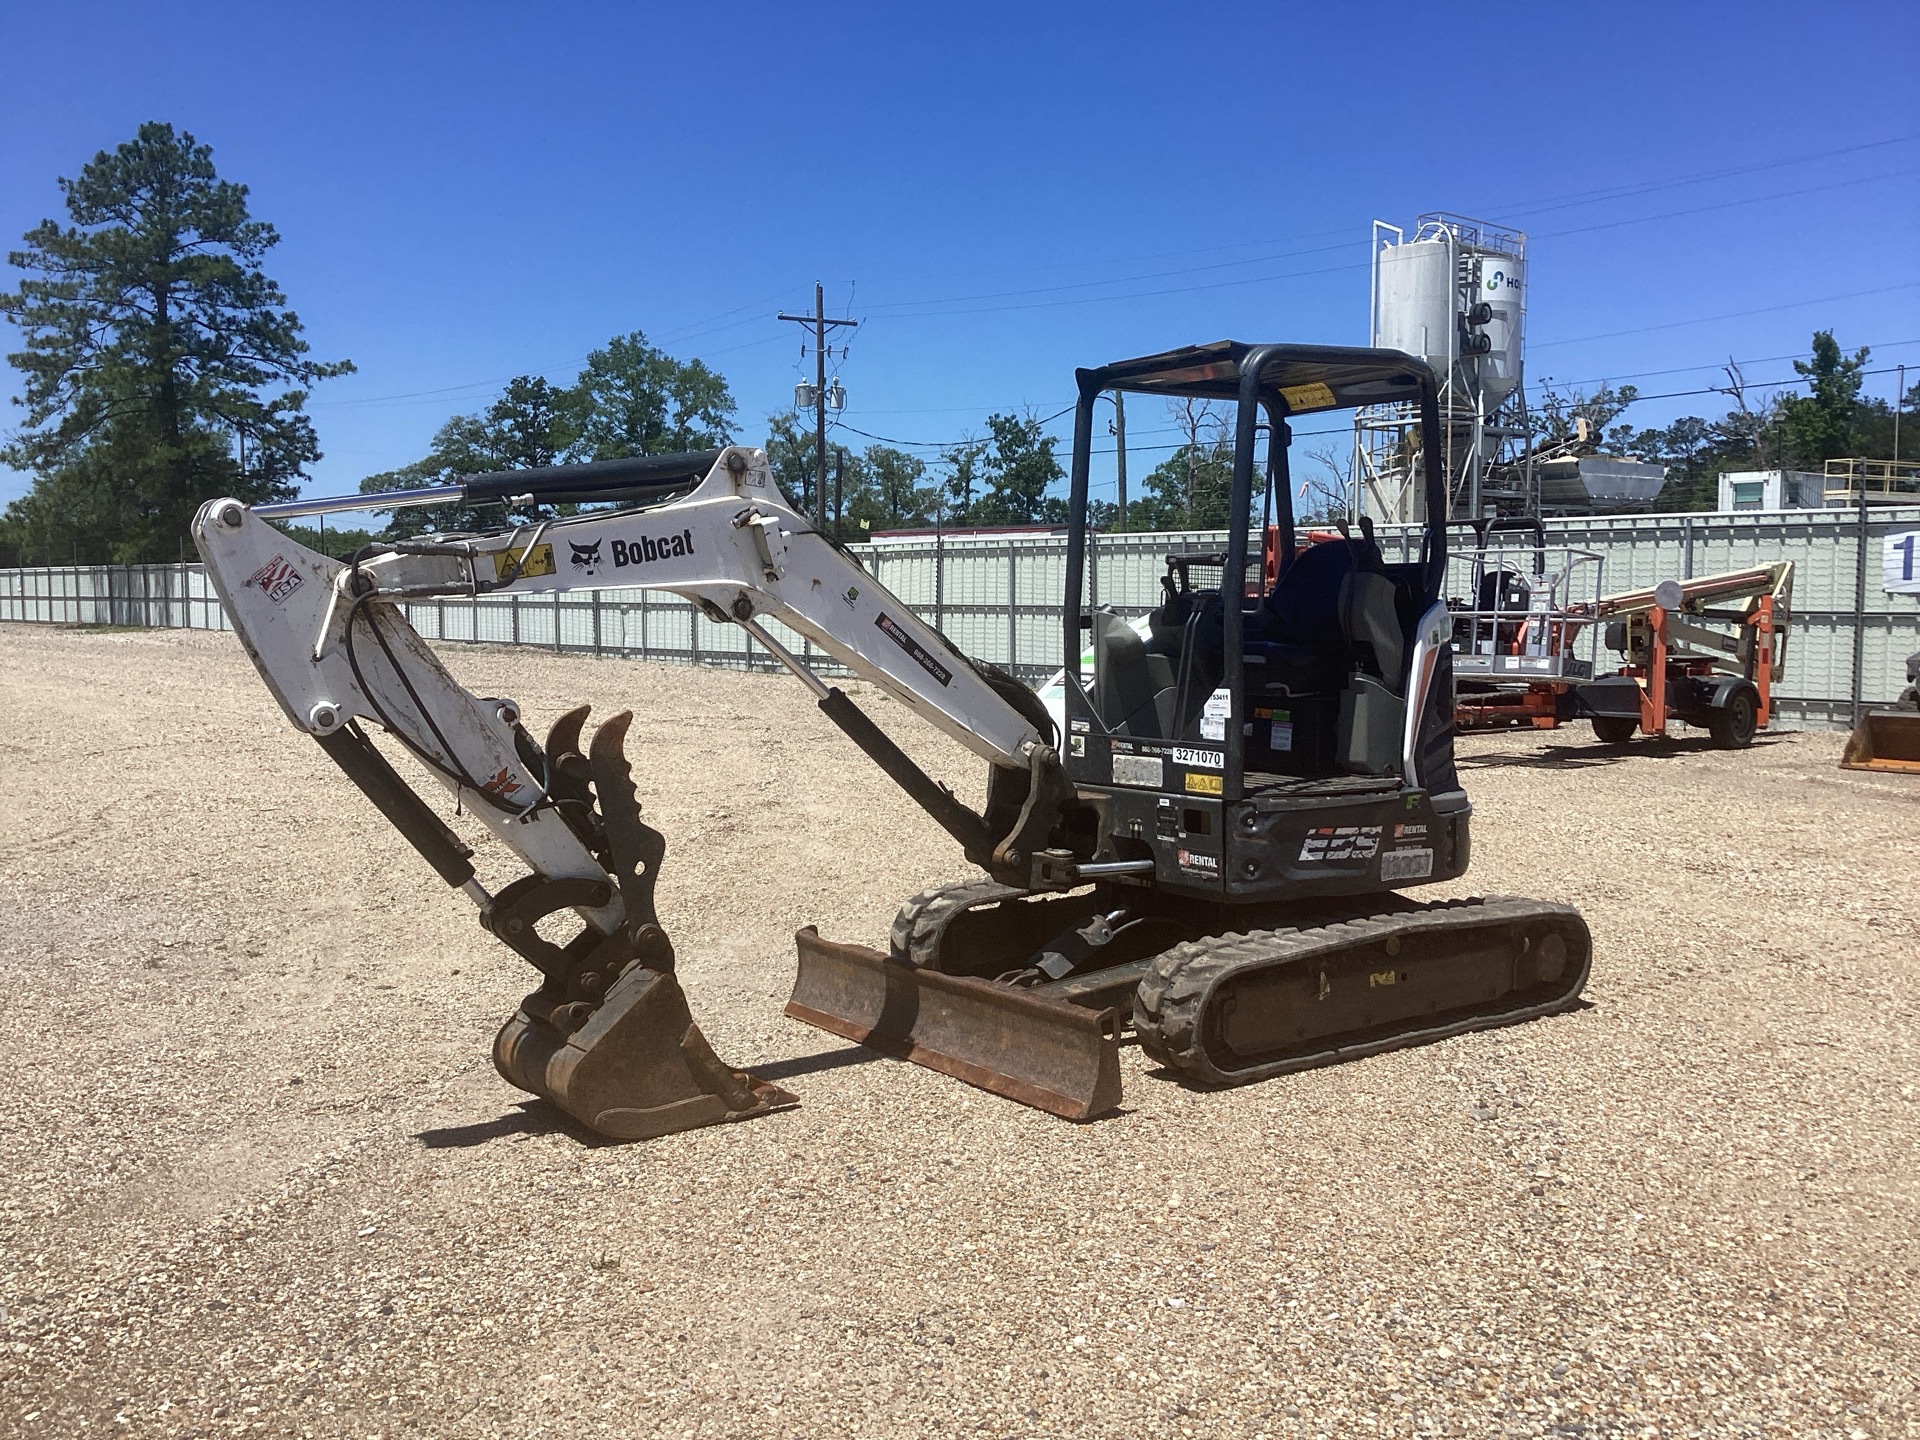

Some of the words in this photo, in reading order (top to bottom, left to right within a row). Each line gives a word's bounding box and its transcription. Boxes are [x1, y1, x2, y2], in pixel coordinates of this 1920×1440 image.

[611, 529, 694, 568] Bobcat
[1893, 536, 1914, 580] 1
[271, 576, 301, 600] USA
[889, 624, 907, 643] RENTAL
[1565, 661, 1587, 677] JLG
[1176, 748, 1221, 765] 3271070
[1403, 824, 1427, 835] RENTAL
[1189, 853, 1218, 868] RENTAL
